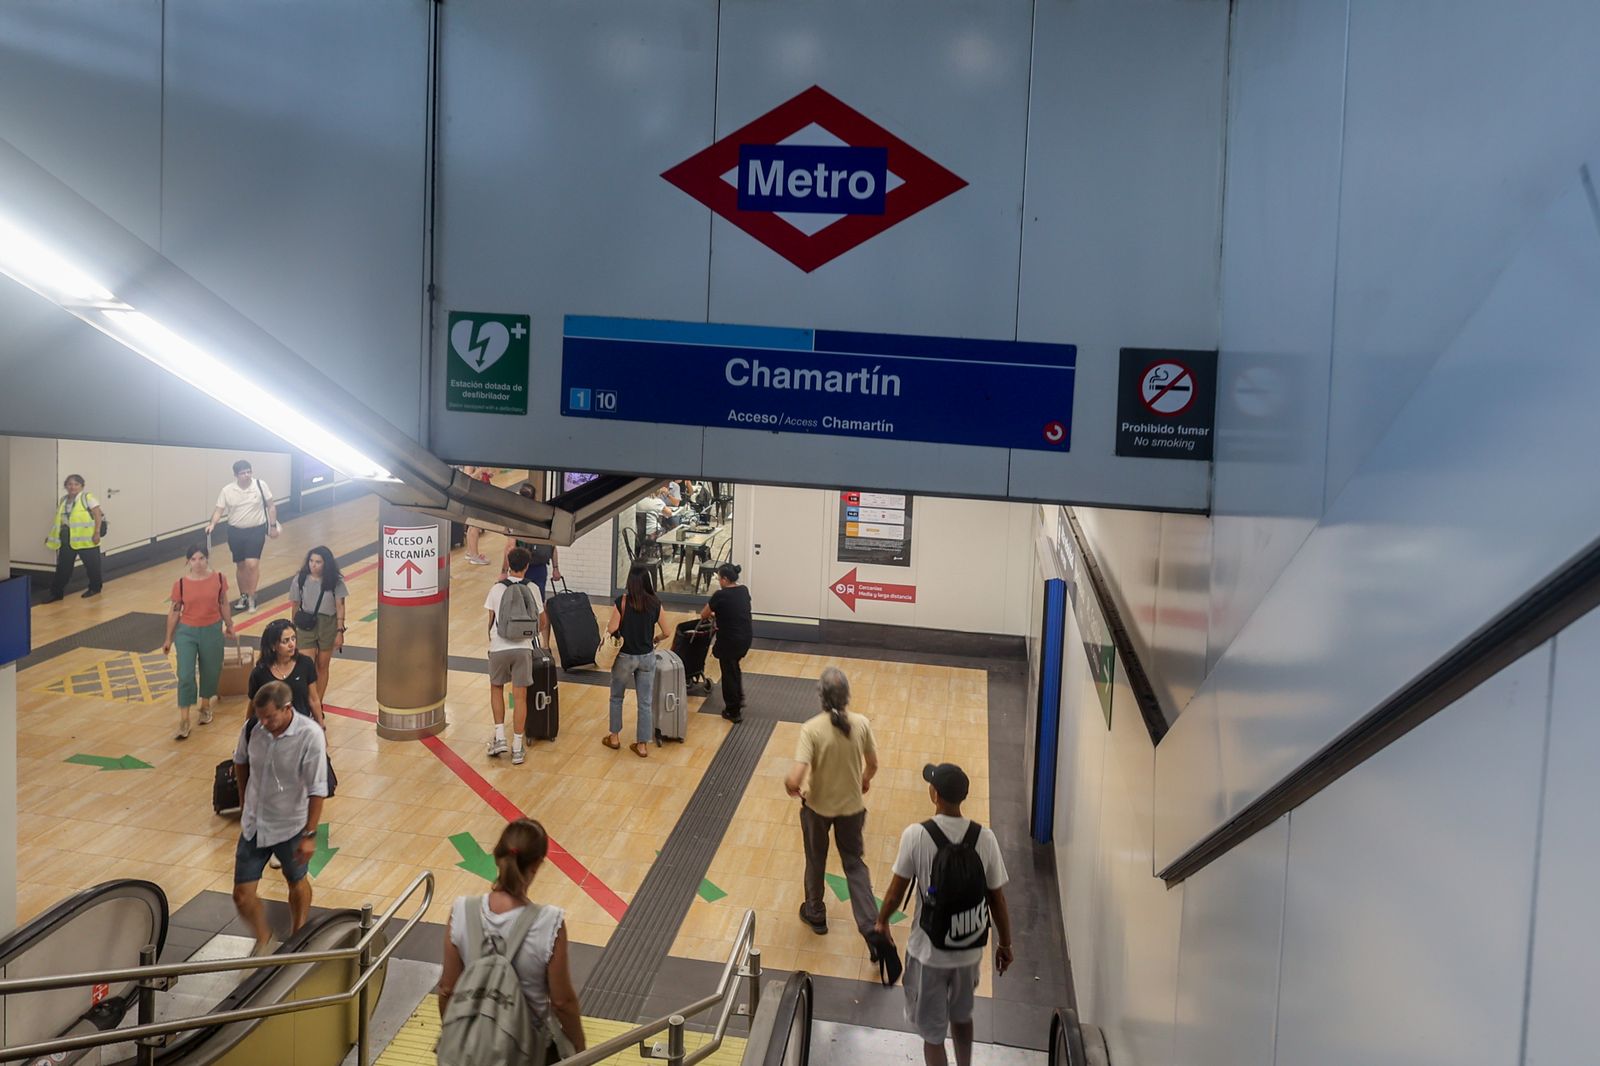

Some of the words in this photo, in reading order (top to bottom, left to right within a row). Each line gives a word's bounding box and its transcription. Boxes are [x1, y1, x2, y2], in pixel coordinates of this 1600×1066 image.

[748, 159, 876, 200] Metro
[725, 357, 901, 397] Chamartín
[450, 380, 483, 389] Estación
[485, 382, 511, 391] dotada
[462, 390, 510, 400] desfibrilador
[577, 391, 585, 408] 1
[596, 392, 616, 410] 10
[822, 416, 894, 433] Chamartín
[1122, 422, 1175, 434] Prohibido
[1177, 425, 1210, 436] fumar
[1134, 436, 1149, 447] No
[1151, 438, 1196, 451] smoking
[388, 536, 424, 546] ACCESO
[426, 535, 433, 545] A
[385, 548, 436, 559] CERCANÍAS
[951, 896, 988, 938] NIKE
